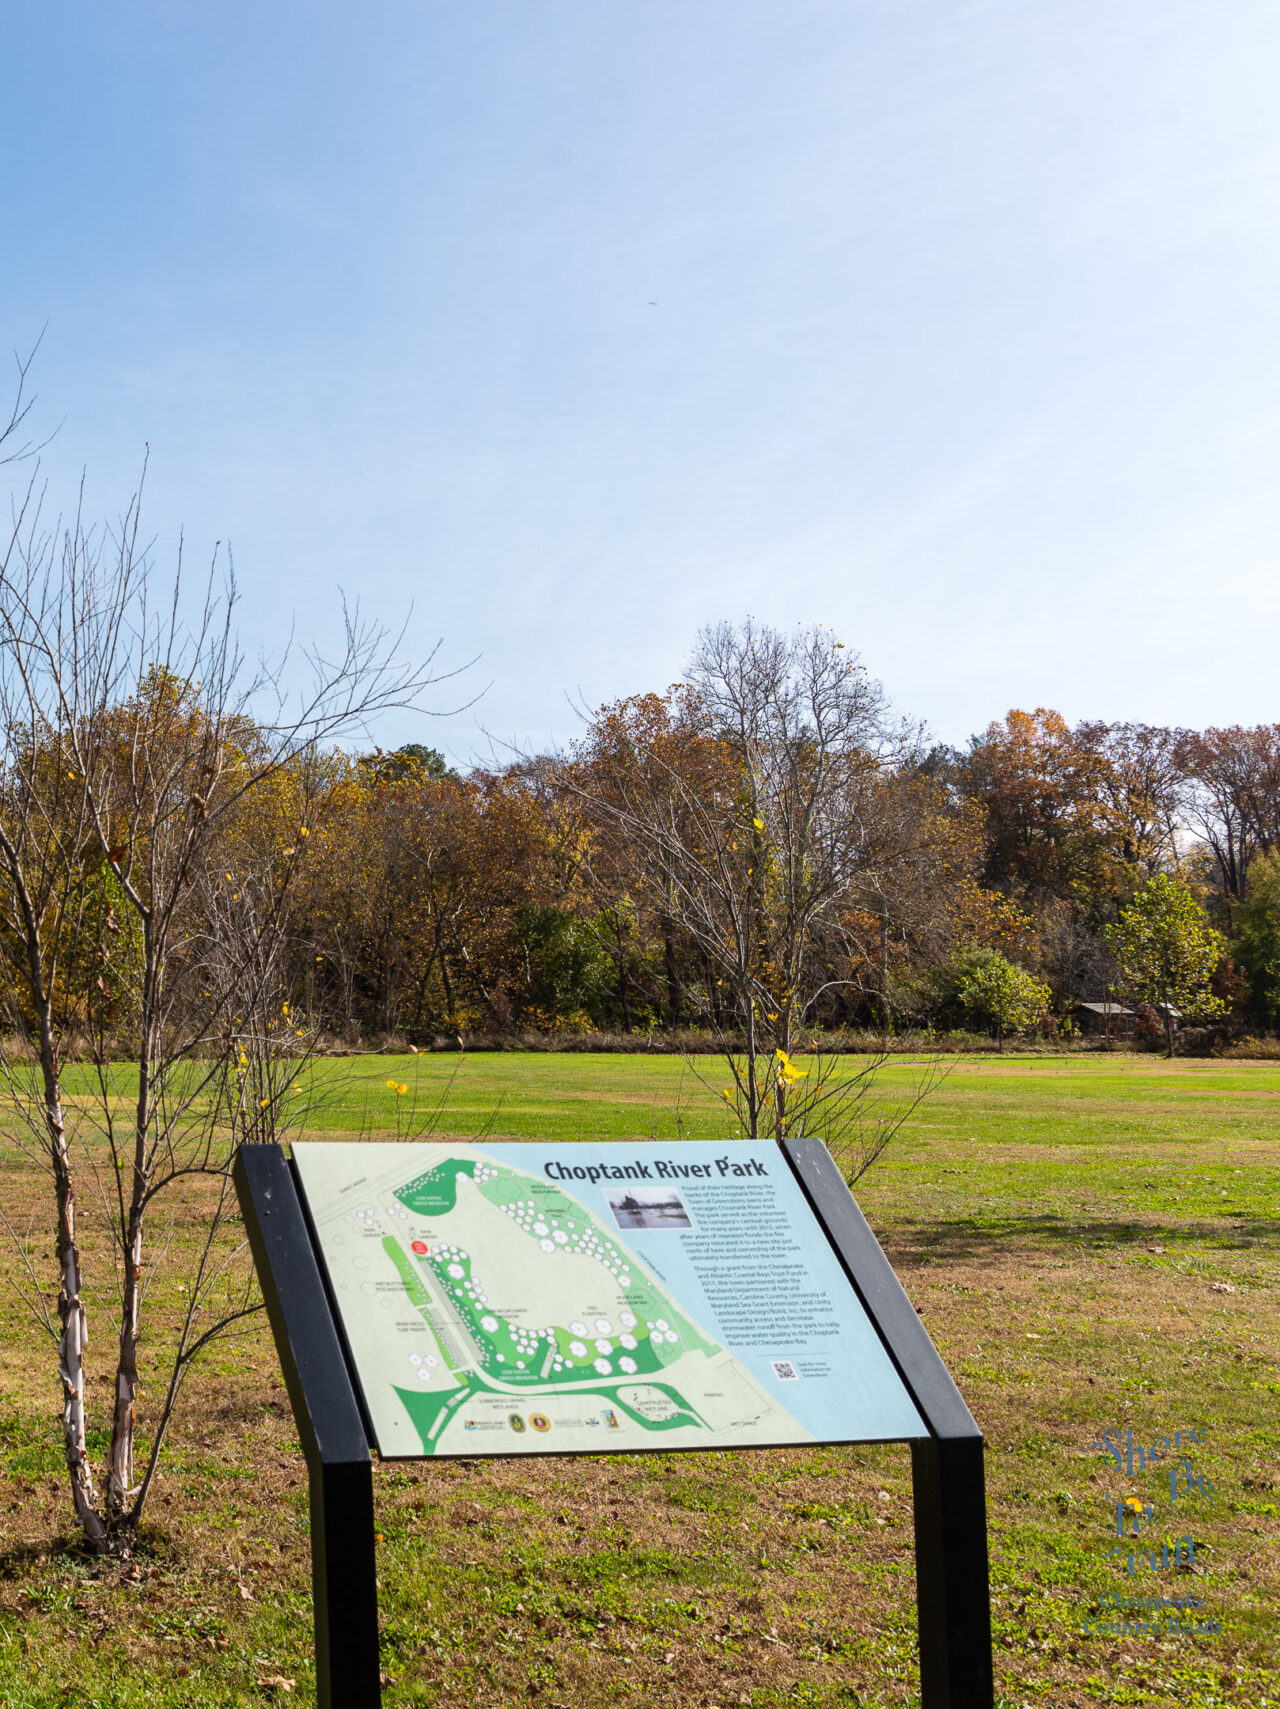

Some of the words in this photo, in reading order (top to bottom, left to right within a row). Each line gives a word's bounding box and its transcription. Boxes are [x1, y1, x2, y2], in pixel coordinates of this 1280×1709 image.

[544, 1161, 654, 1184] Choptank
[654, 1161, 711, 1178] River
[714, 1158, 769, 1177] Park
